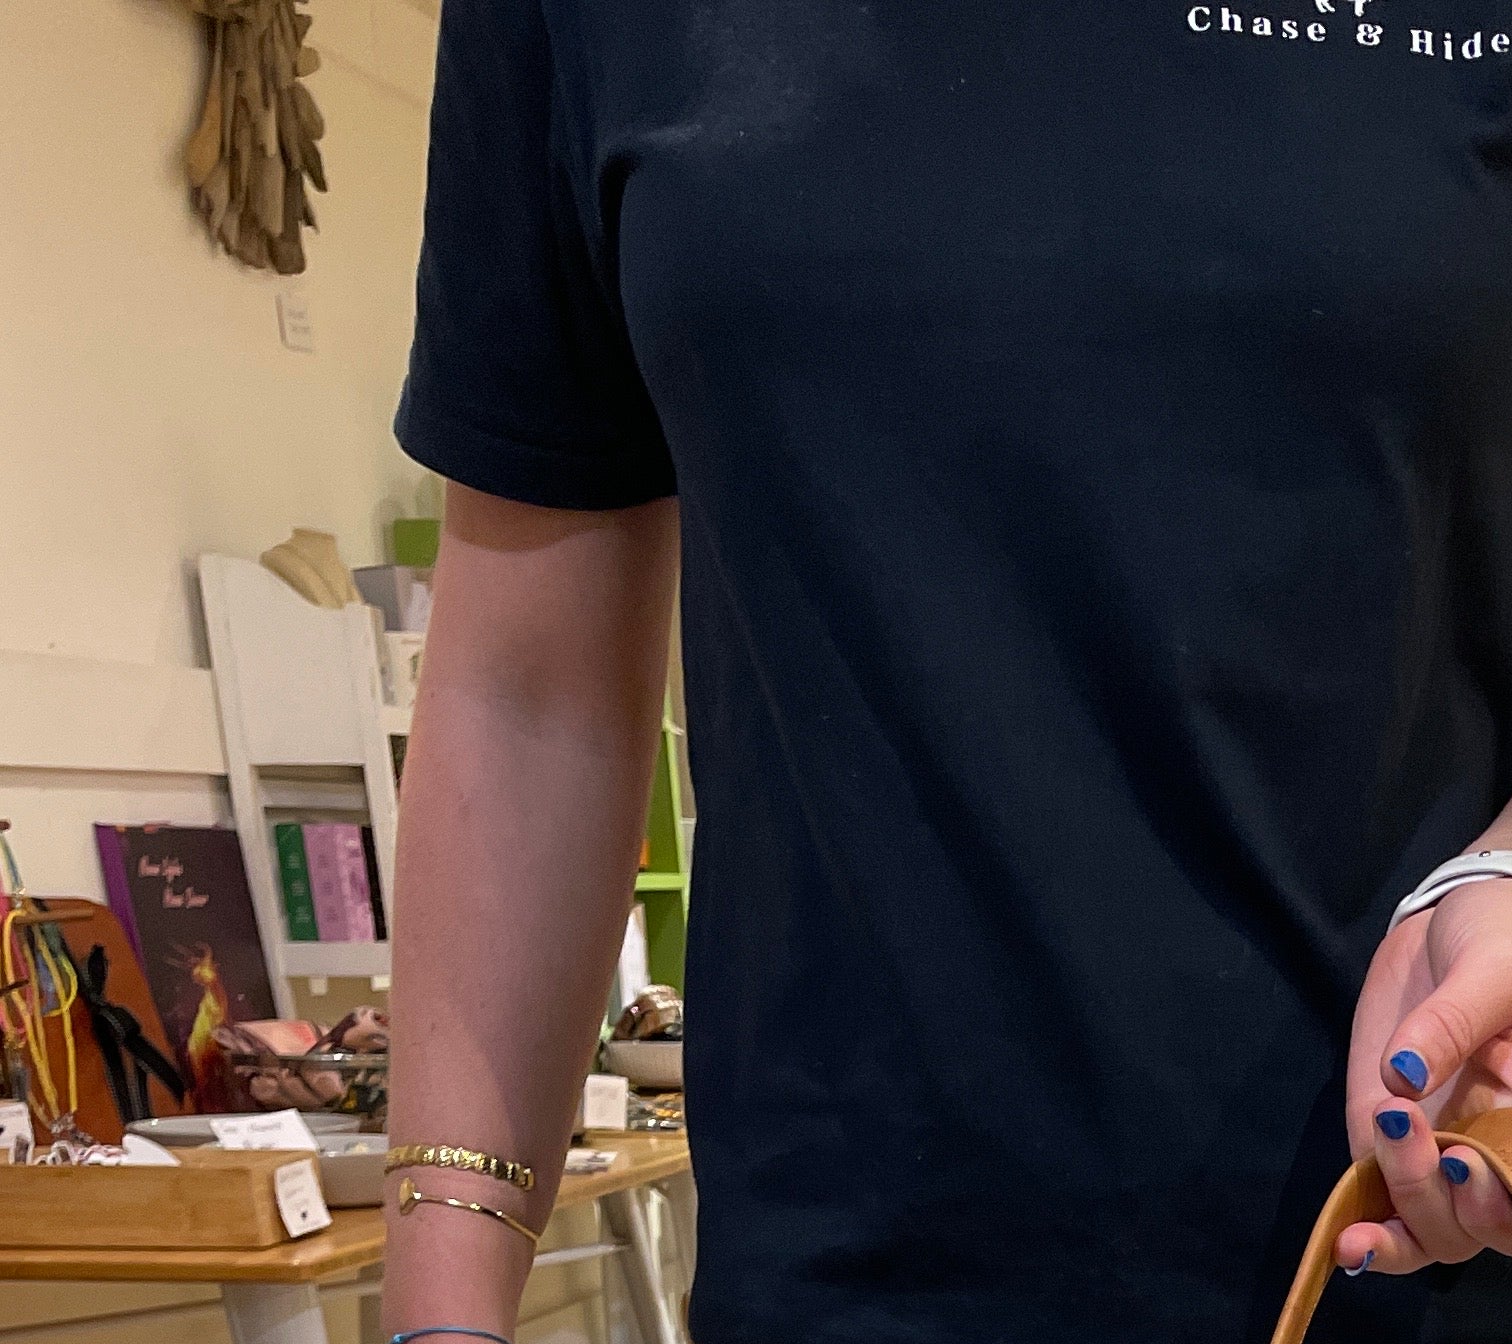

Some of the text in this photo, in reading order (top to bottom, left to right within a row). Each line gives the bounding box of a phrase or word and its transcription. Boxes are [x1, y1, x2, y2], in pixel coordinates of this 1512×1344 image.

[1187, 6, 1511, 61] Chase & Hide
